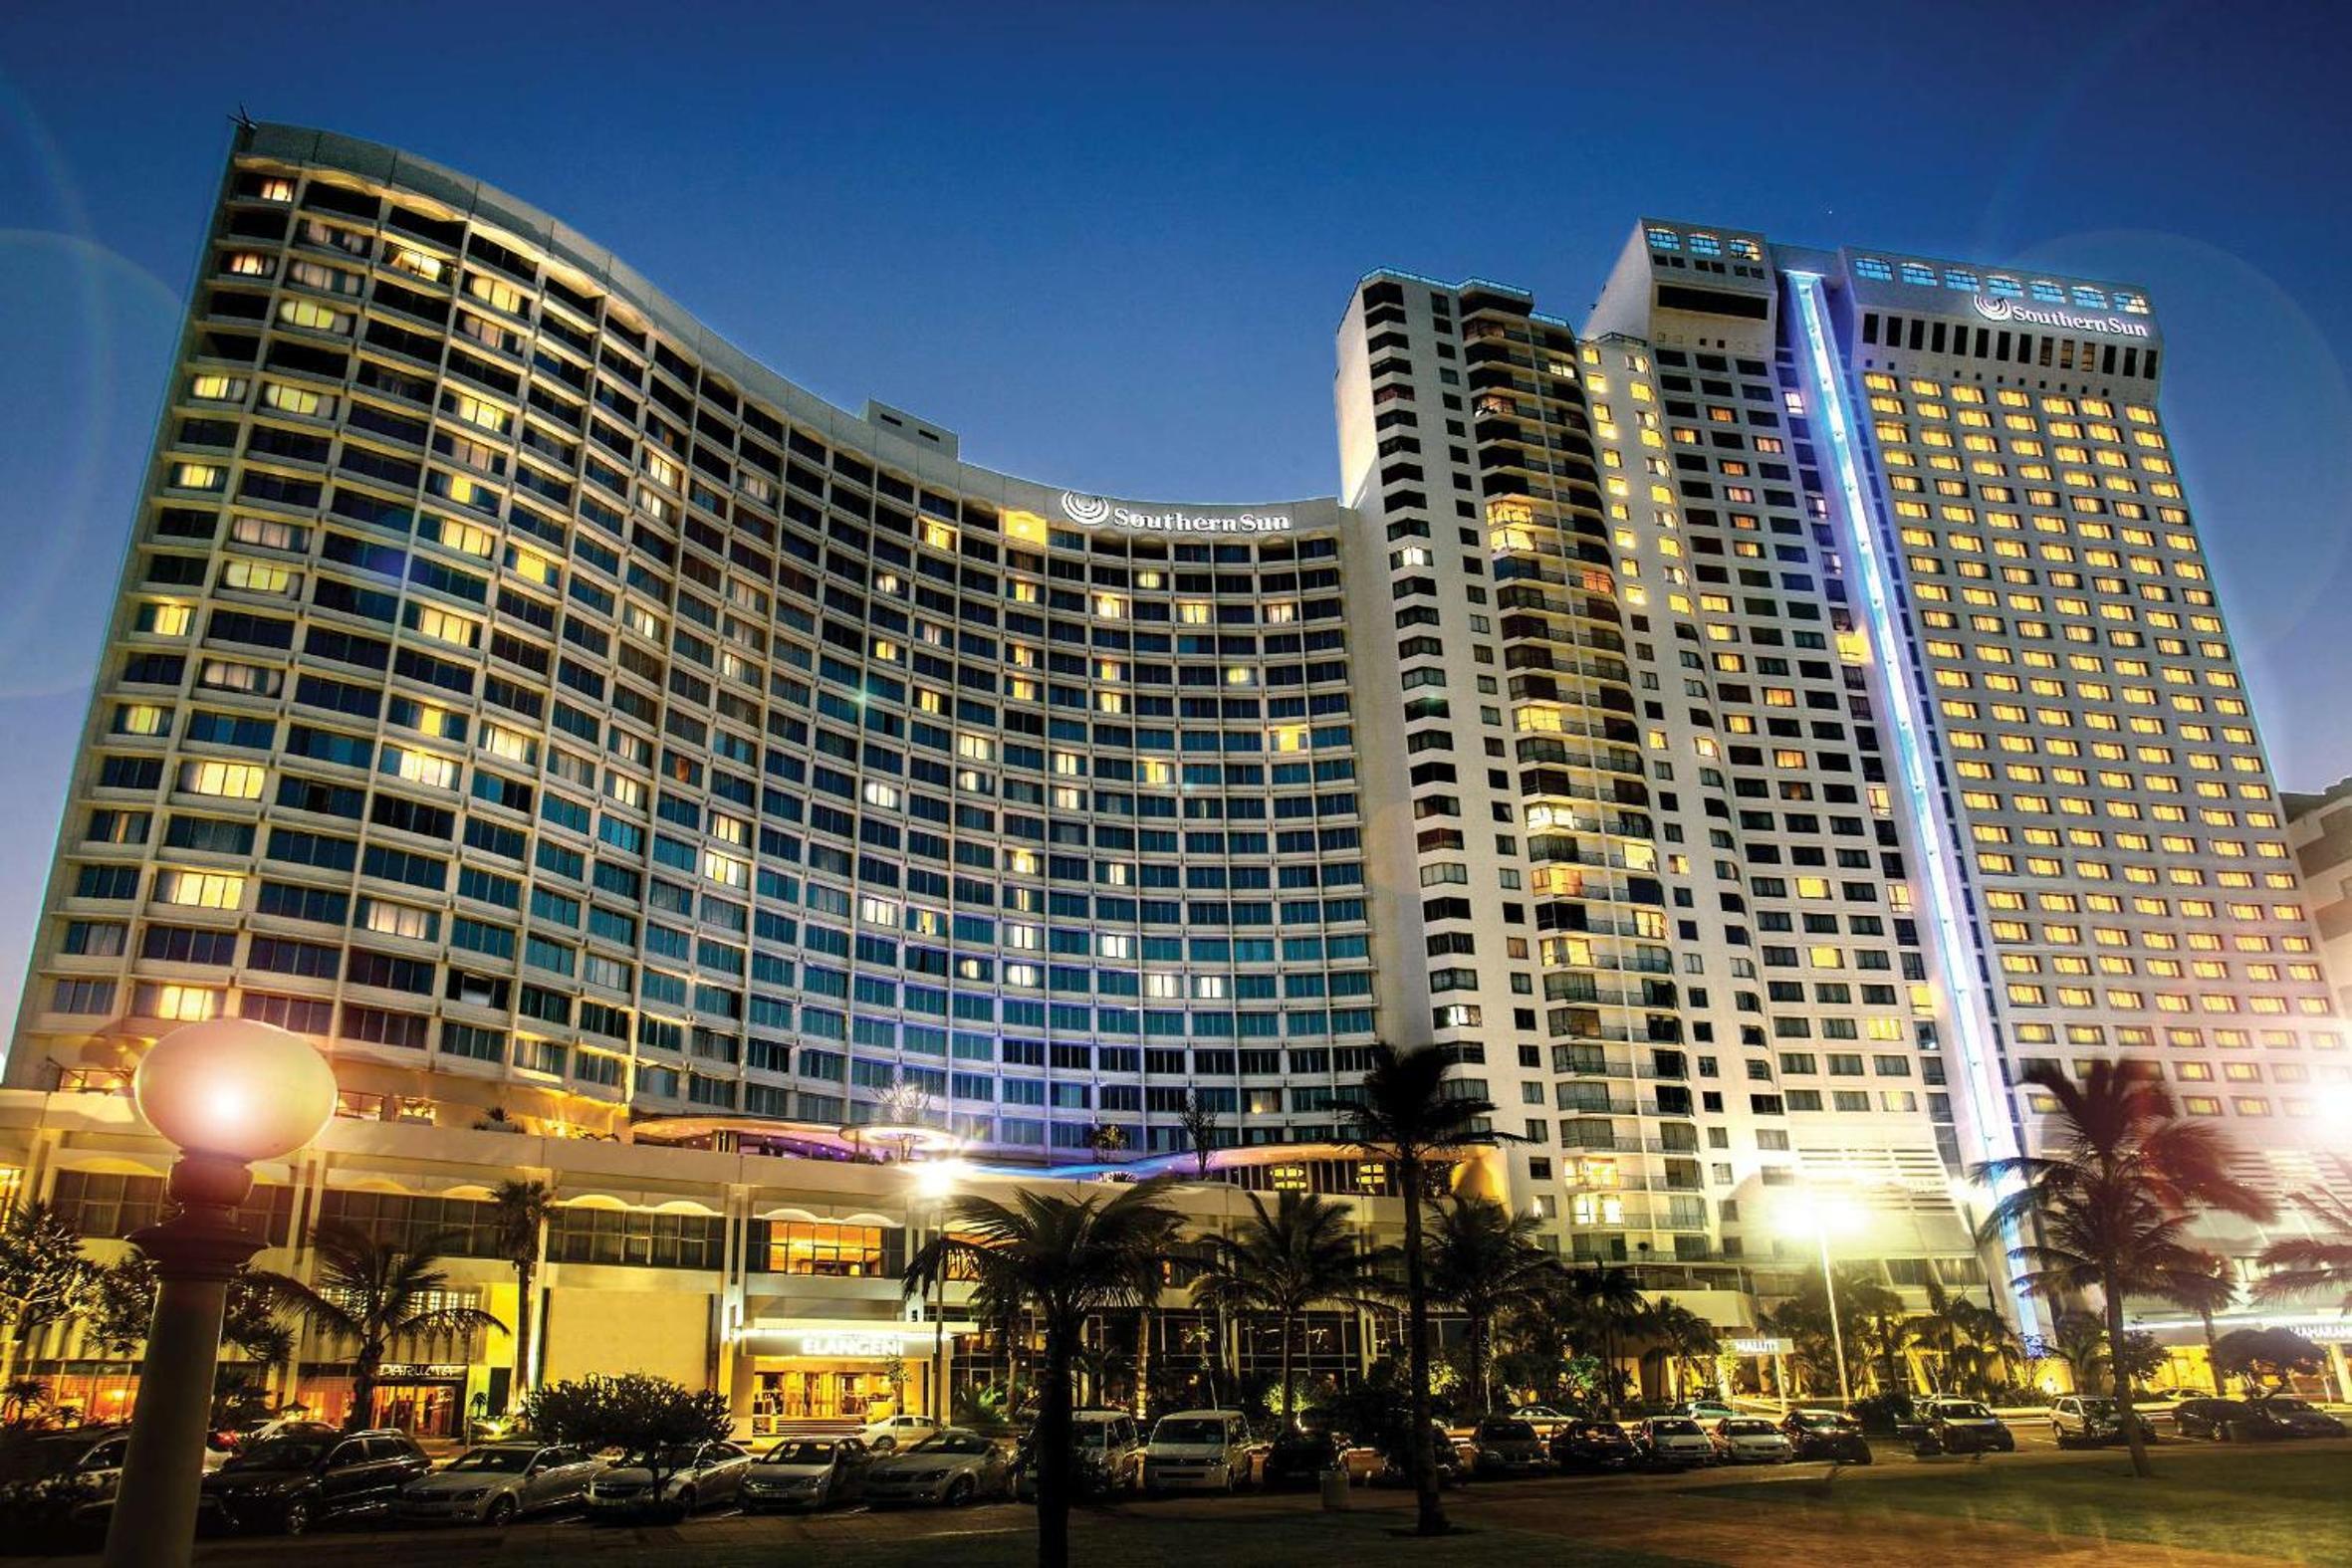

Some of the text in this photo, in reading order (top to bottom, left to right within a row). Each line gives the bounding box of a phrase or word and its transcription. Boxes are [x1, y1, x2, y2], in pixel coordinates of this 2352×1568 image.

[2012, 306, 2148, 336] Southern Sun
[1114, 509, 1291, 532] Southern Sun
[802, 1337, 904, 1355] ELANGENI
